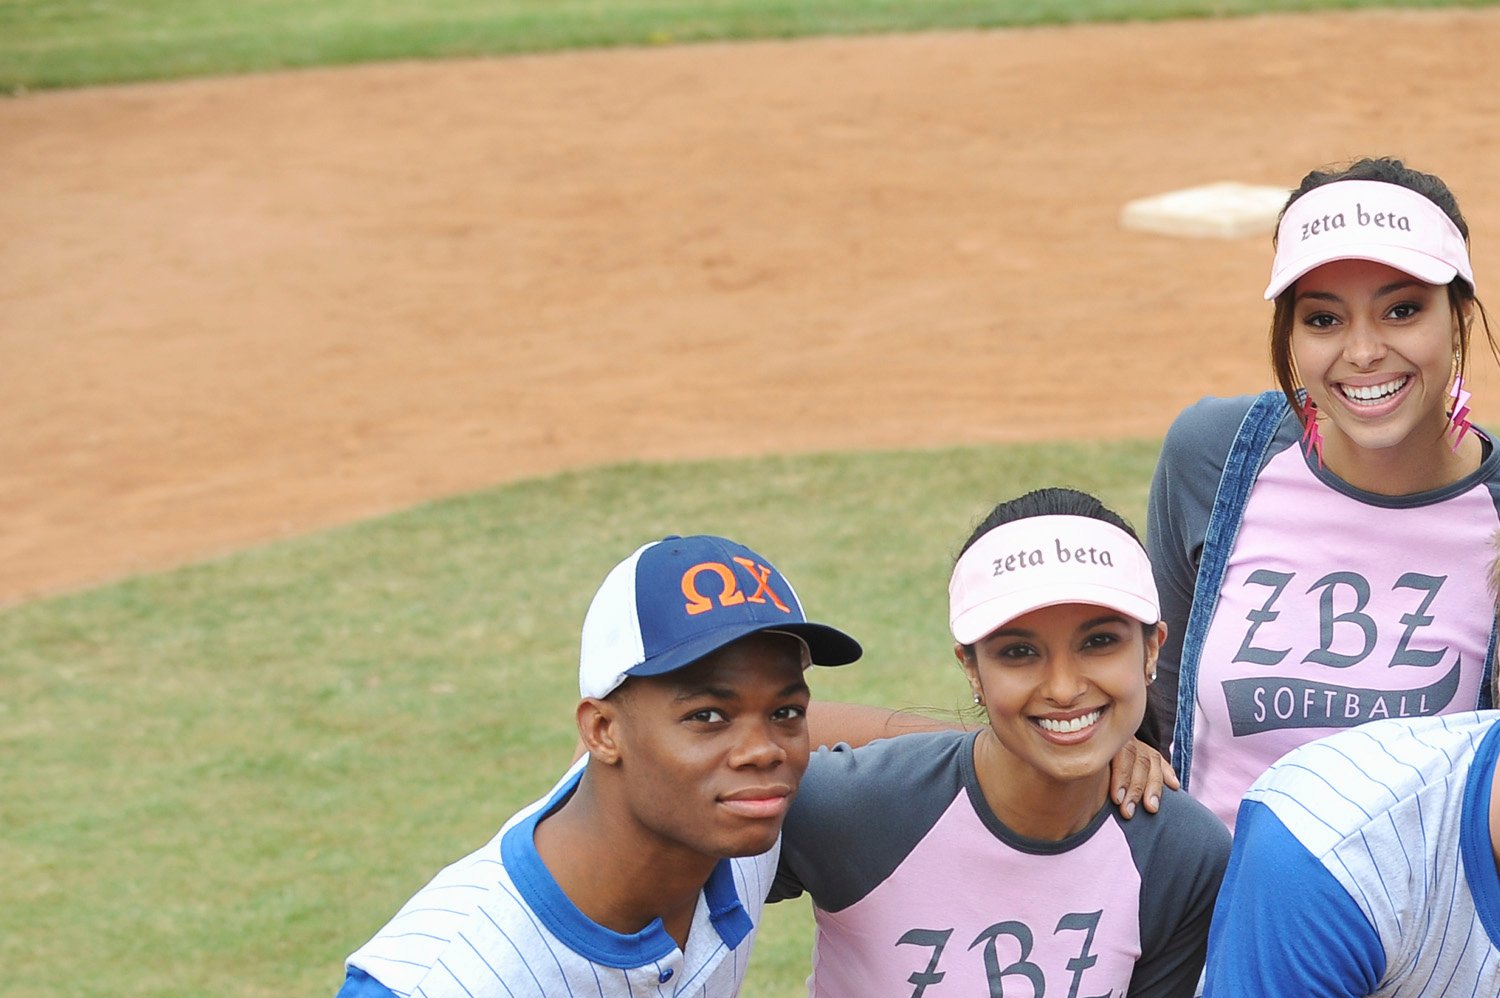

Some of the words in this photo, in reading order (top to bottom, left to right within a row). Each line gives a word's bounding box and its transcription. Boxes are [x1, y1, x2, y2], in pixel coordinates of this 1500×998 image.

[1301, 212, 1347, 241] zeta
[1356, 202, 1412, 232] beta
[992, 548, 1045, 577] zeta
[1054, 537, 1115, 568] beta
[1231, 568, 1450, 669] ZBZ
[1252, 685, 1431, 723] SOFTBALL
